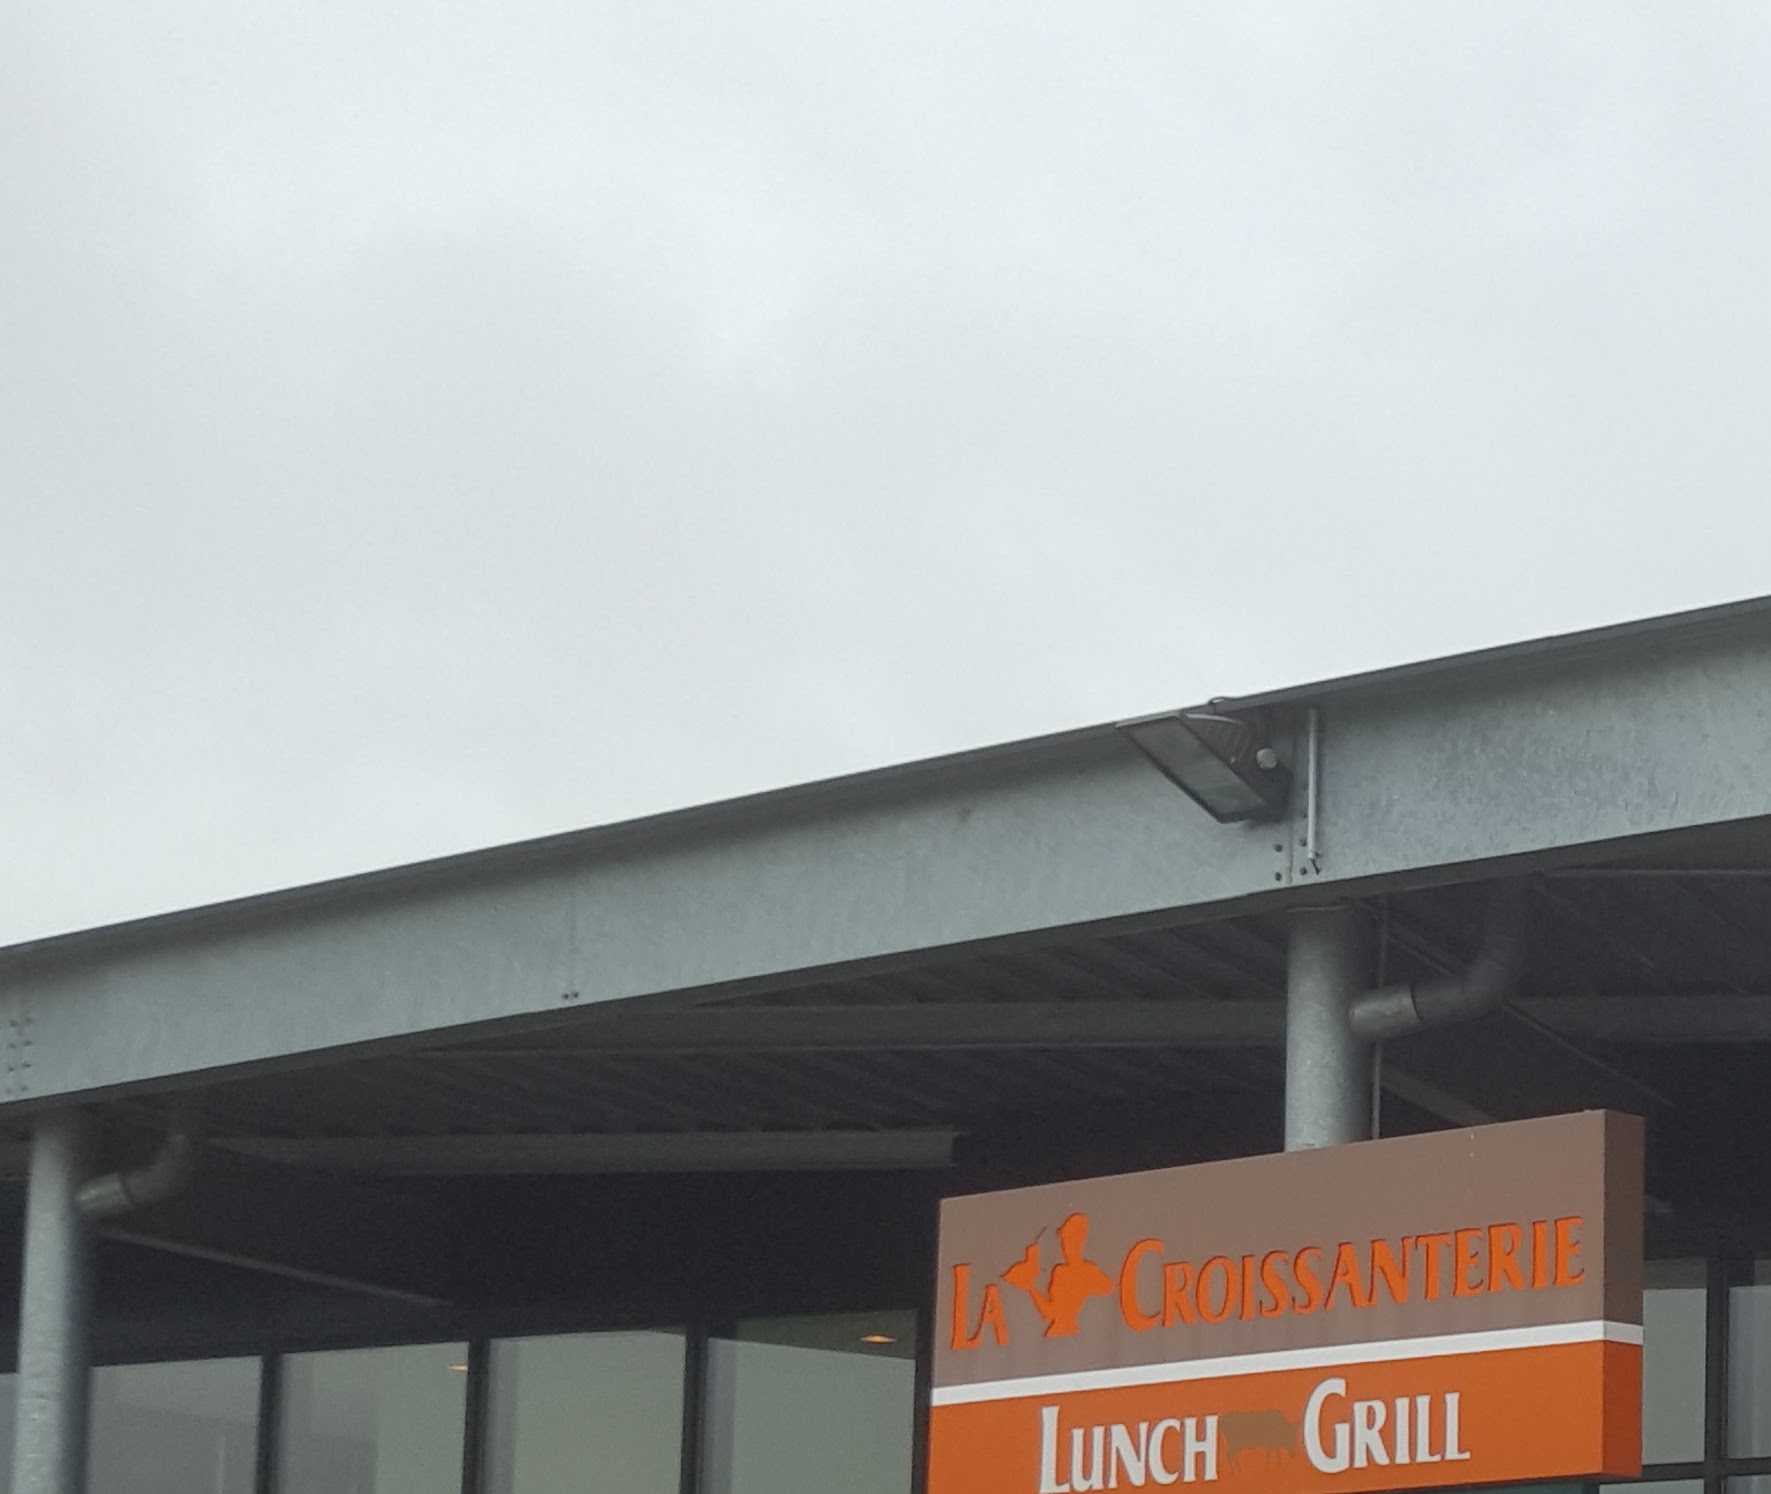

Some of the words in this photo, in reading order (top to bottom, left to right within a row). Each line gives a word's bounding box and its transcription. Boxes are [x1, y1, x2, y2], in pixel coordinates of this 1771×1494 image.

[1118, 1214, 1587, 1333] CROISSANTERIE
[1037, 1405, 1219, 1494] LUNCH
[1303, 1377, 1471, 1474] GRILL
